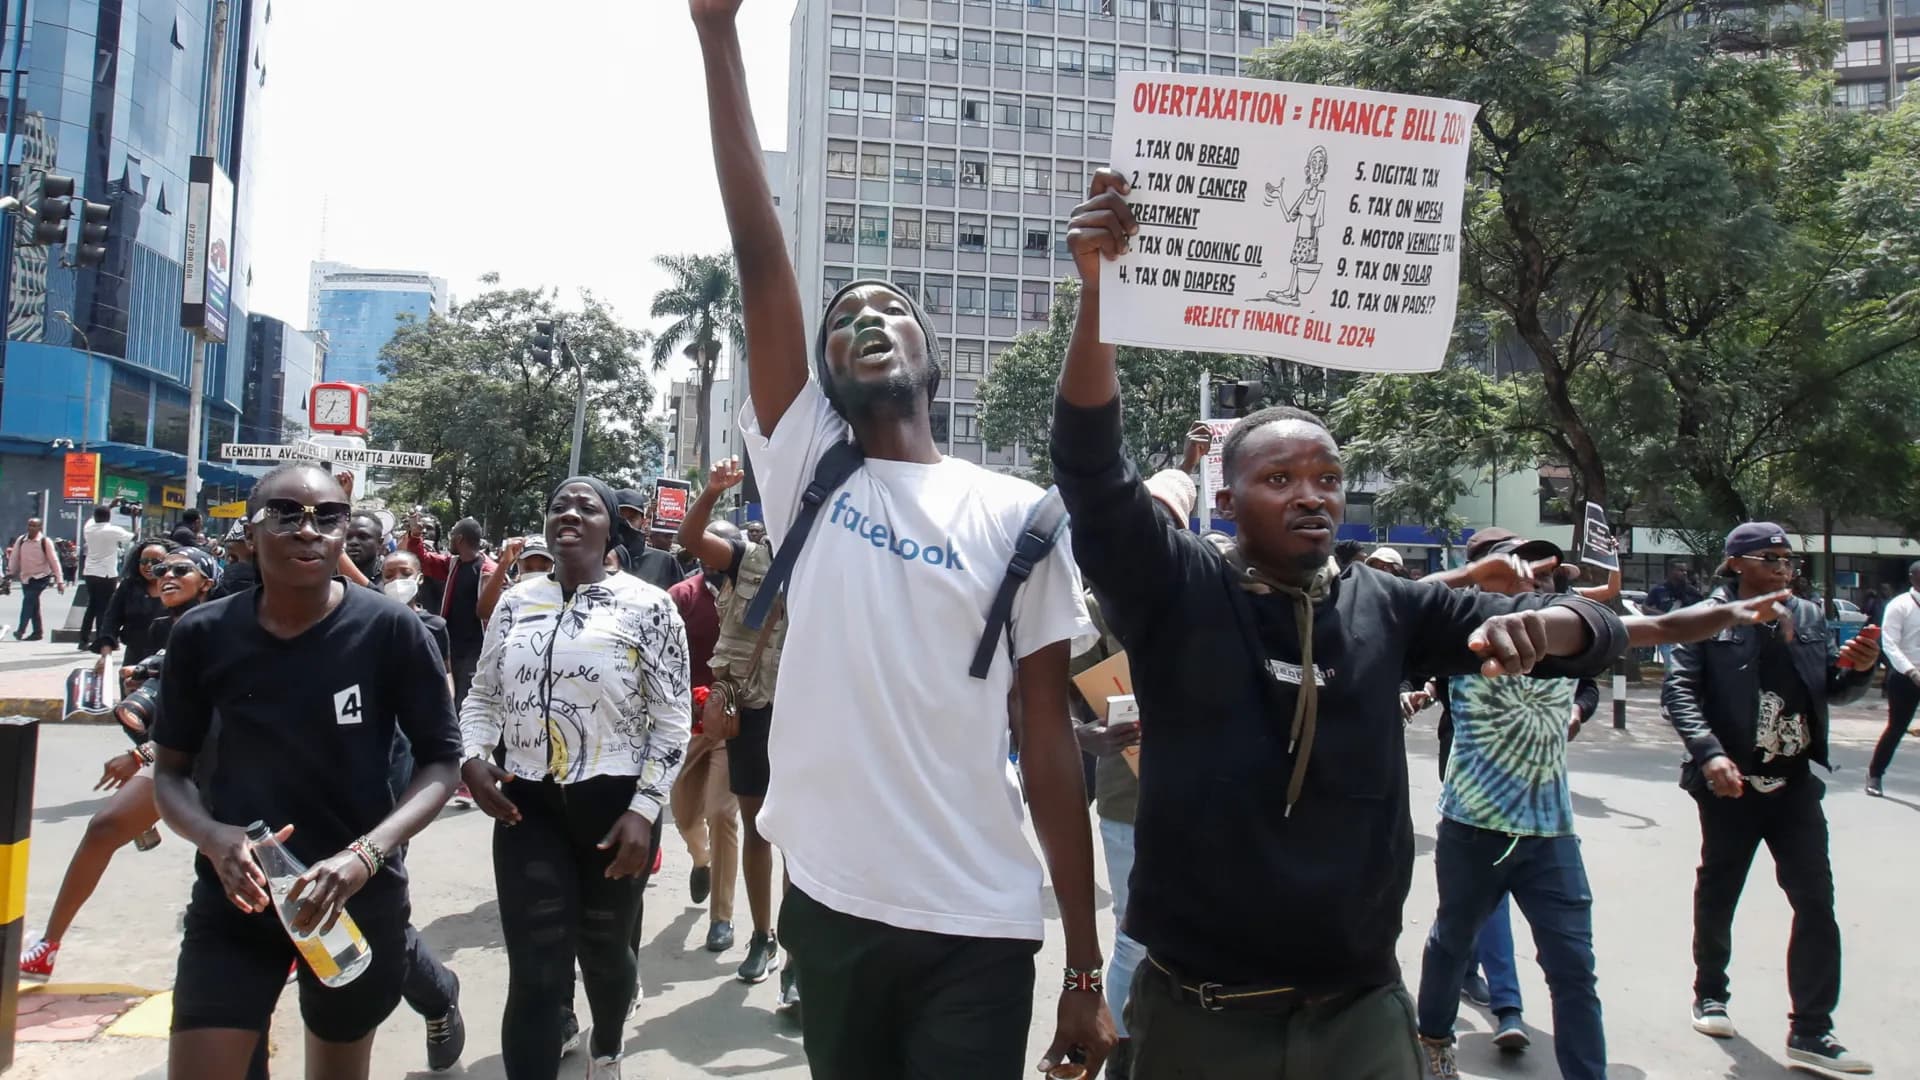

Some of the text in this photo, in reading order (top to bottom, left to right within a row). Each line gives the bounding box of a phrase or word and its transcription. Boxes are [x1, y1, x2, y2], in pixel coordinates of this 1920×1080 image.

[1133, 82, 1288, 126] OVERTAXATION
[1308, 97, 1398, 138] FINANCE
[1401, 107, 1437, 142] BILL
[1175, 141, 1195, 162] ON
[1198, 144, 1240, 167] BREAD
[1131, 170, 1248, 200] 2. TAX ON CANCER
[1355, 161, 1440, 188] 5. DIGITAL TAX
[1128, 202, 1201, 227] TREATMENT
[1348, 193, 1444, 220] 6. TAX ON MPESA
[1138, 235, 1162, 255] TAX
[1166, 237, 1184, 257] ON
[1187, 239, 1241, 263] COOKING
[1244, 245, 1263, 264] OIL
[1342, 226, 1456, 253] 8. MOTOR VEHICLE TAX
[1119, 265, 1236, 294] 4. TAX ON DIAPERS
[1336, 257, 1433, 285] 9. TAX ON SOLAR
[1330, 288, 1351, 309] 10.
[1357, 292, 1381, 312] TAX
[1383, 294, 1401, 314] ON
[1183, 305, 1376, 348] #REJECT FINANCE BILL 2024
[224, 445, 272, 459] KENYATTA
[334, 448, 384, 464] KENYATTA
[388, 452, 426, 467] AVENUE
[341, 692, 362, 718] 4
